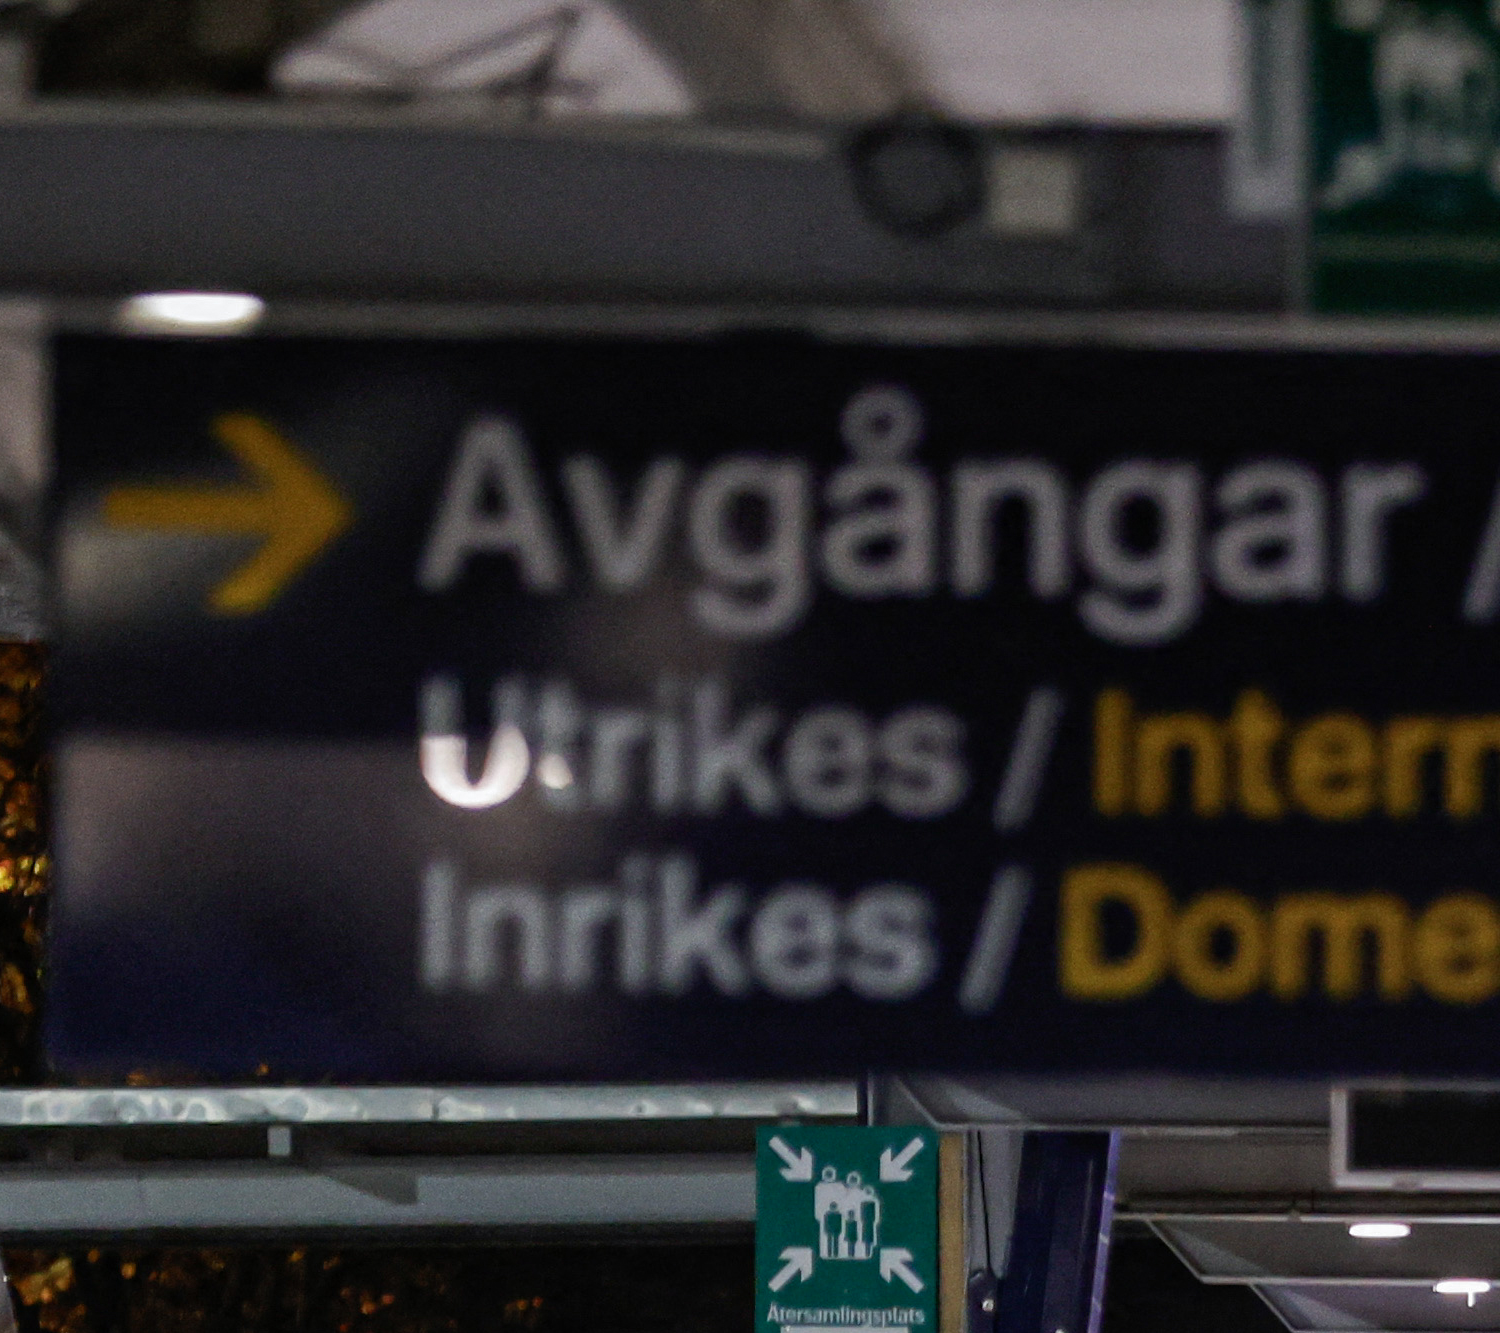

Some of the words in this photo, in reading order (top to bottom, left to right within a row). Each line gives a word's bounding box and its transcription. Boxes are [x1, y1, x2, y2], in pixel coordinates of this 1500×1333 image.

[414, 384, 1428, 645] Avgångar
[416, 674, 970, 820] Utrikes
[990, 684, 1064, 832] /
[416, 852, 938, 1001] Inrikes
[956, 862, 1036, 1016] /
